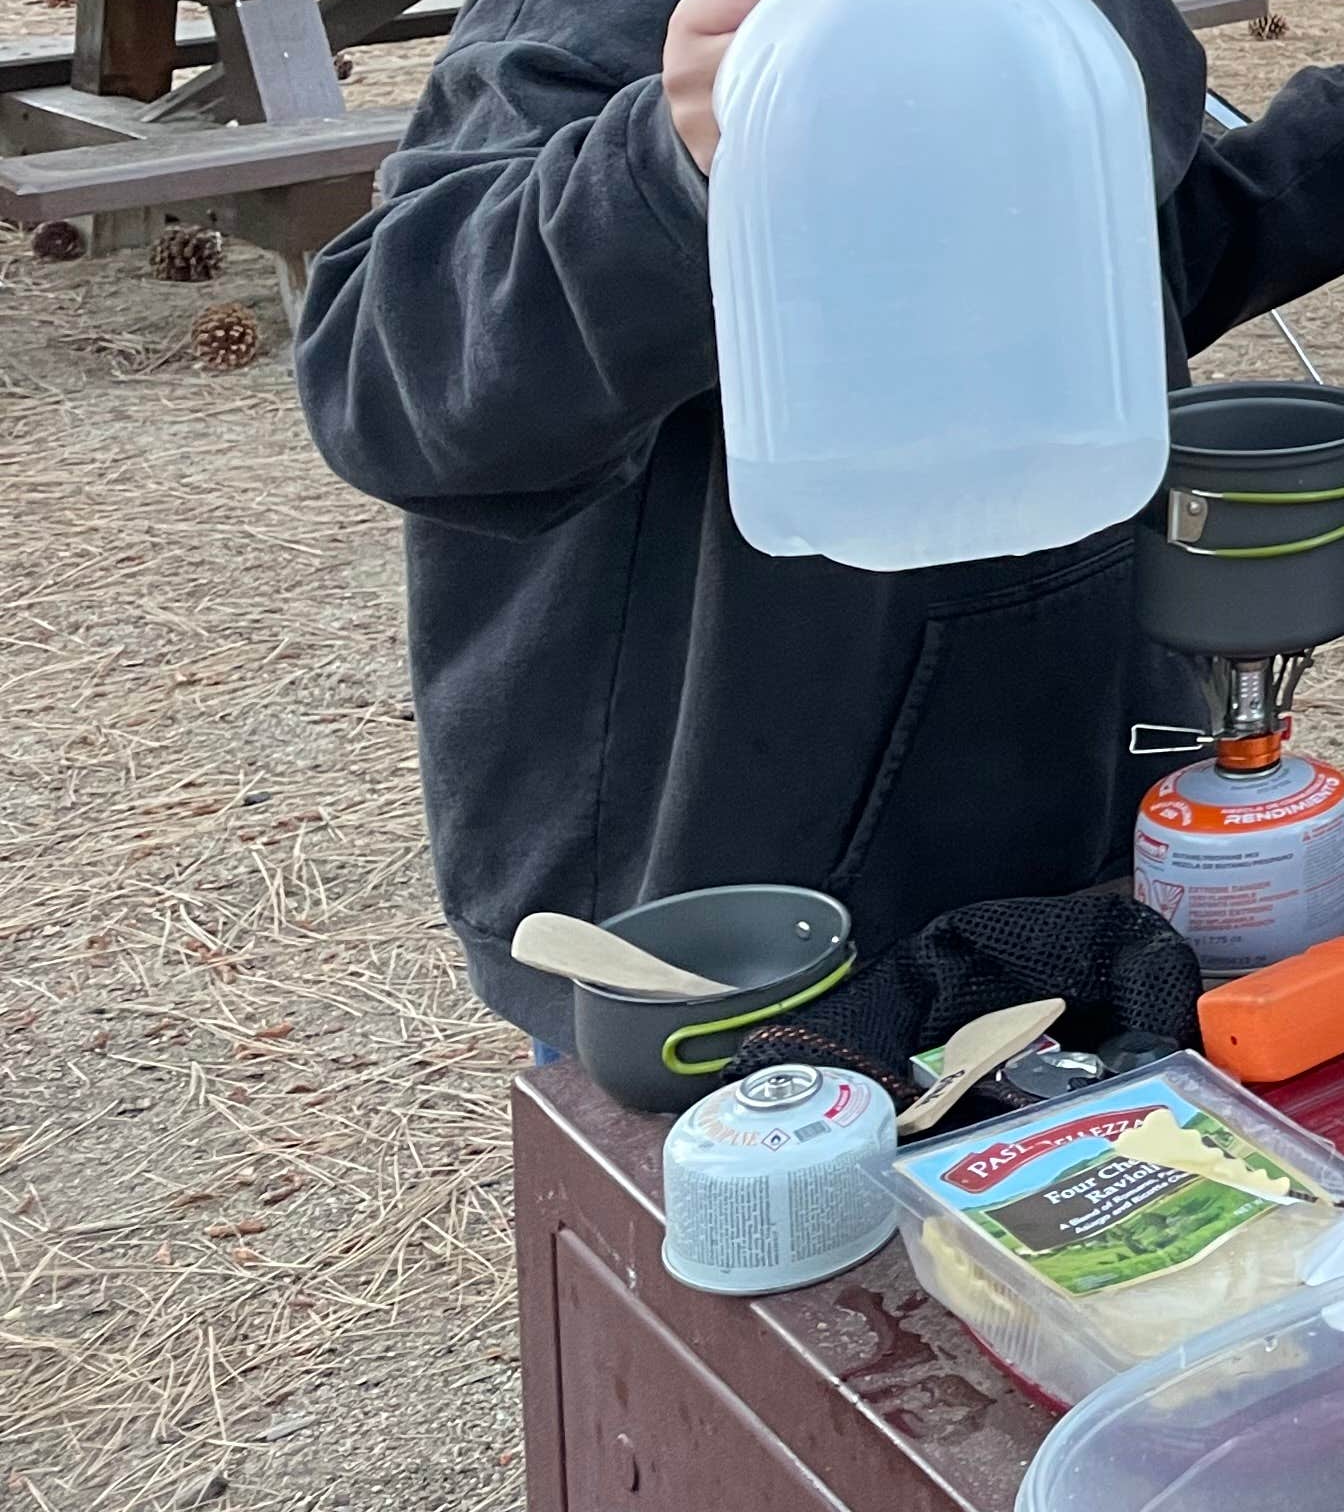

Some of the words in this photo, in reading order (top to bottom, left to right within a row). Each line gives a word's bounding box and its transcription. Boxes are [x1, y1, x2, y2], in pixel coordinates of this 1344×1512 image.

[1223, 776, 1341, 826] RENDIMIENTO
[967, 1140, 1034, 1178] PAST
[1042, 1177, 1098, 1205] Four
